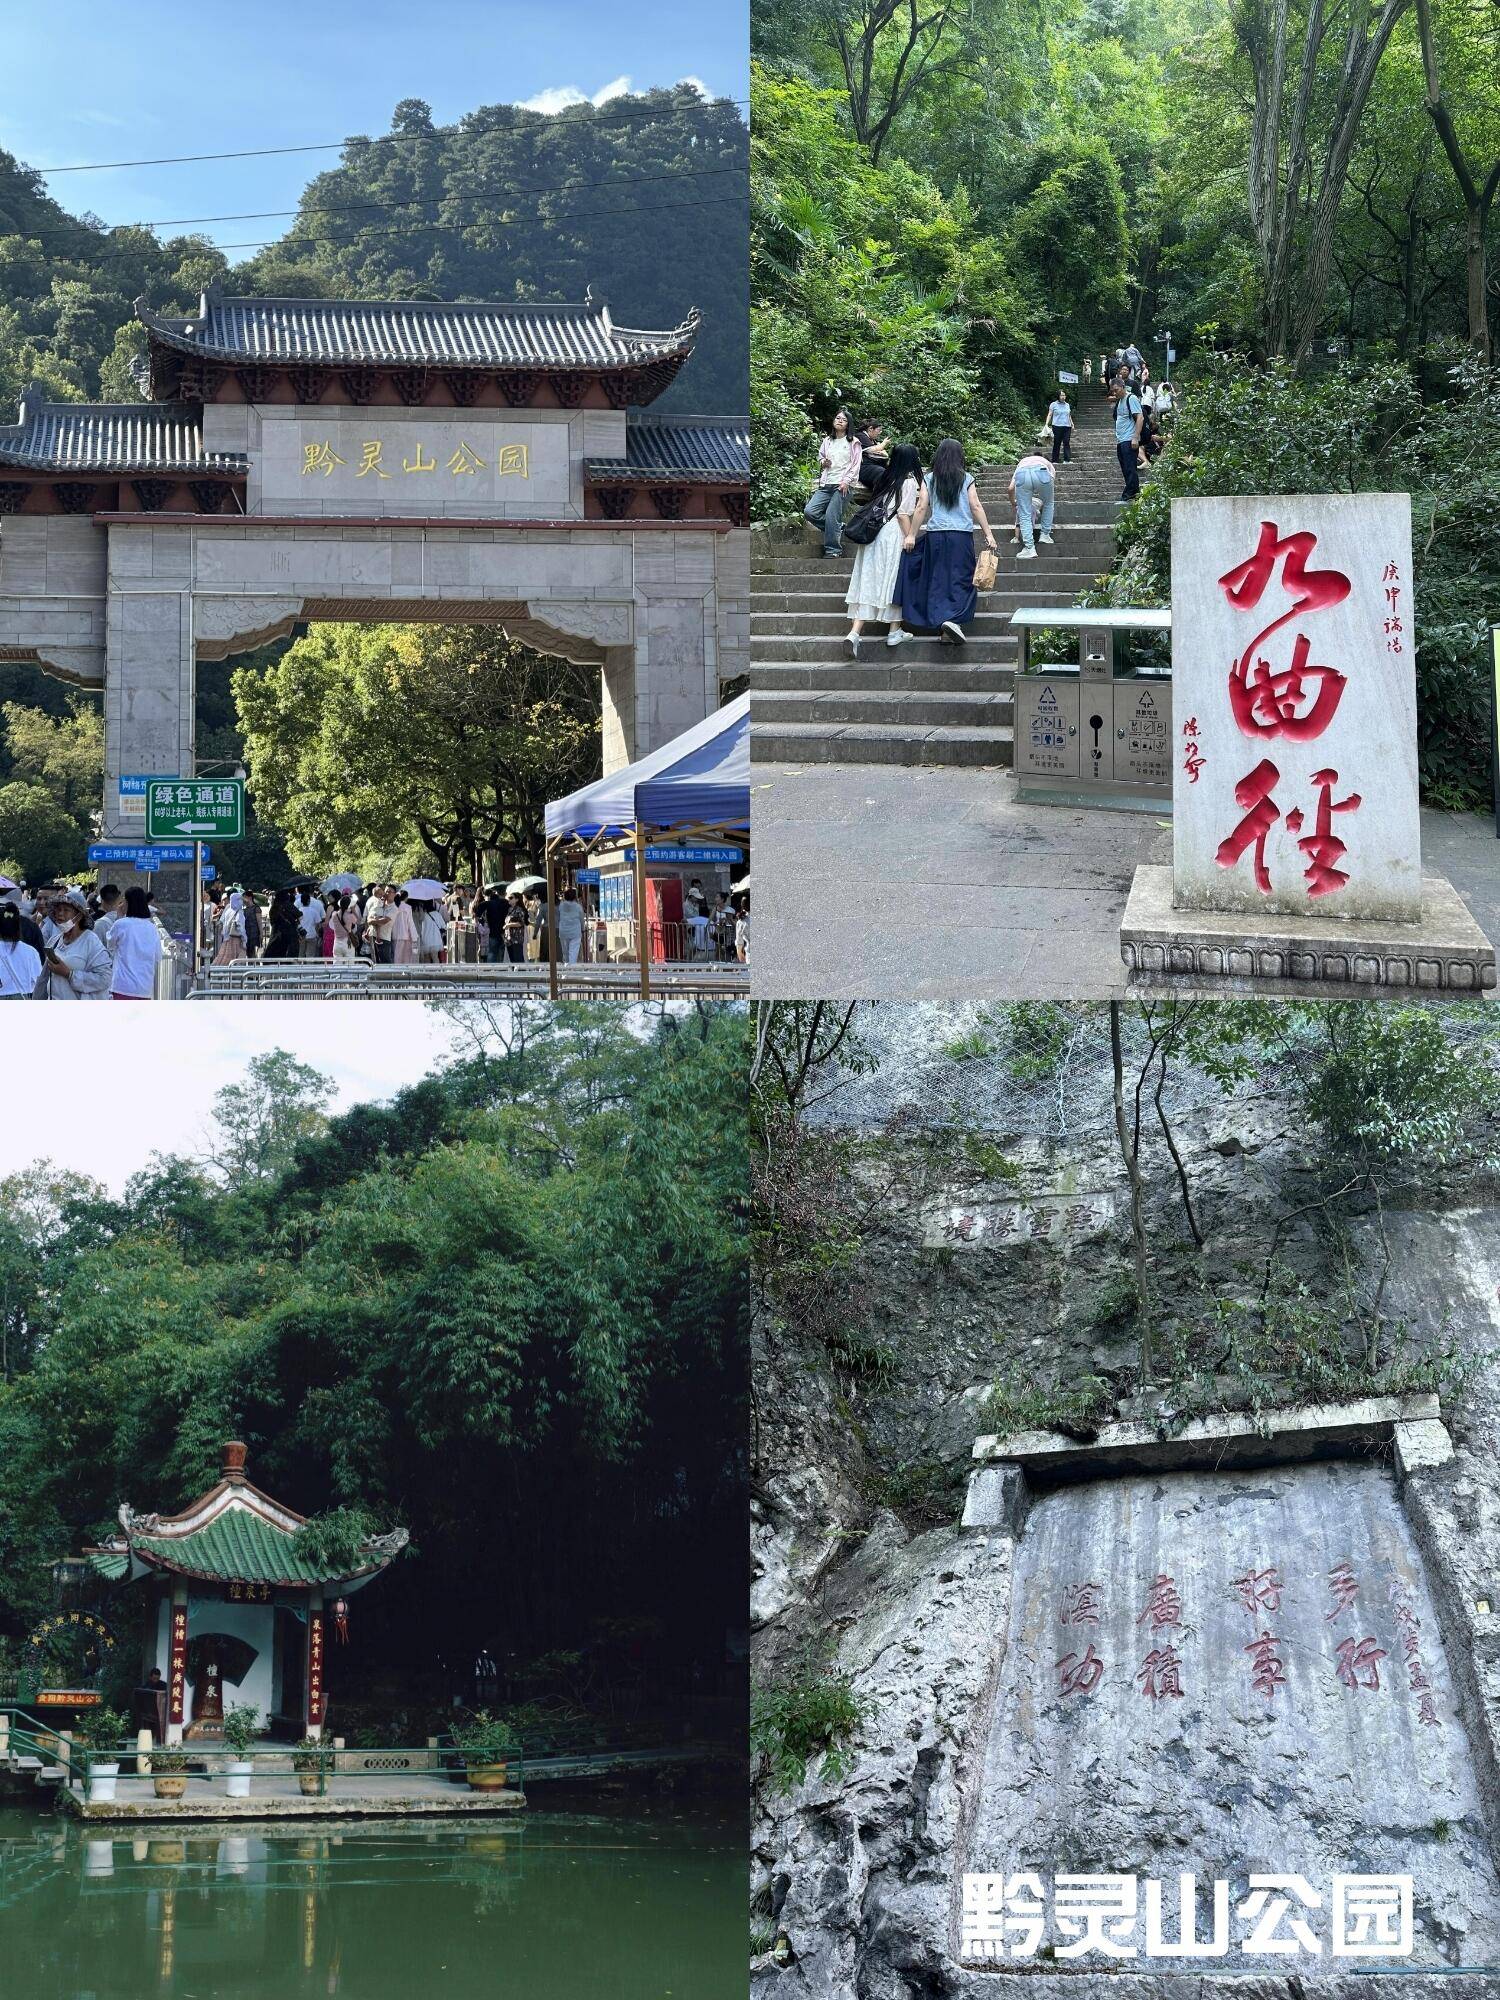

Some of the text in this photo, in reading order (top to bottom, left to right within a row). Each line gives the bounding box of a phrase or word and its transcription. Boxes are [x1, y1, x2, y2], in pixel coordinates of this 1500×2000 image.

[301, 441, 530, 480] 黔灵山公园
[155, 786, 235, 805] 绿色通道
